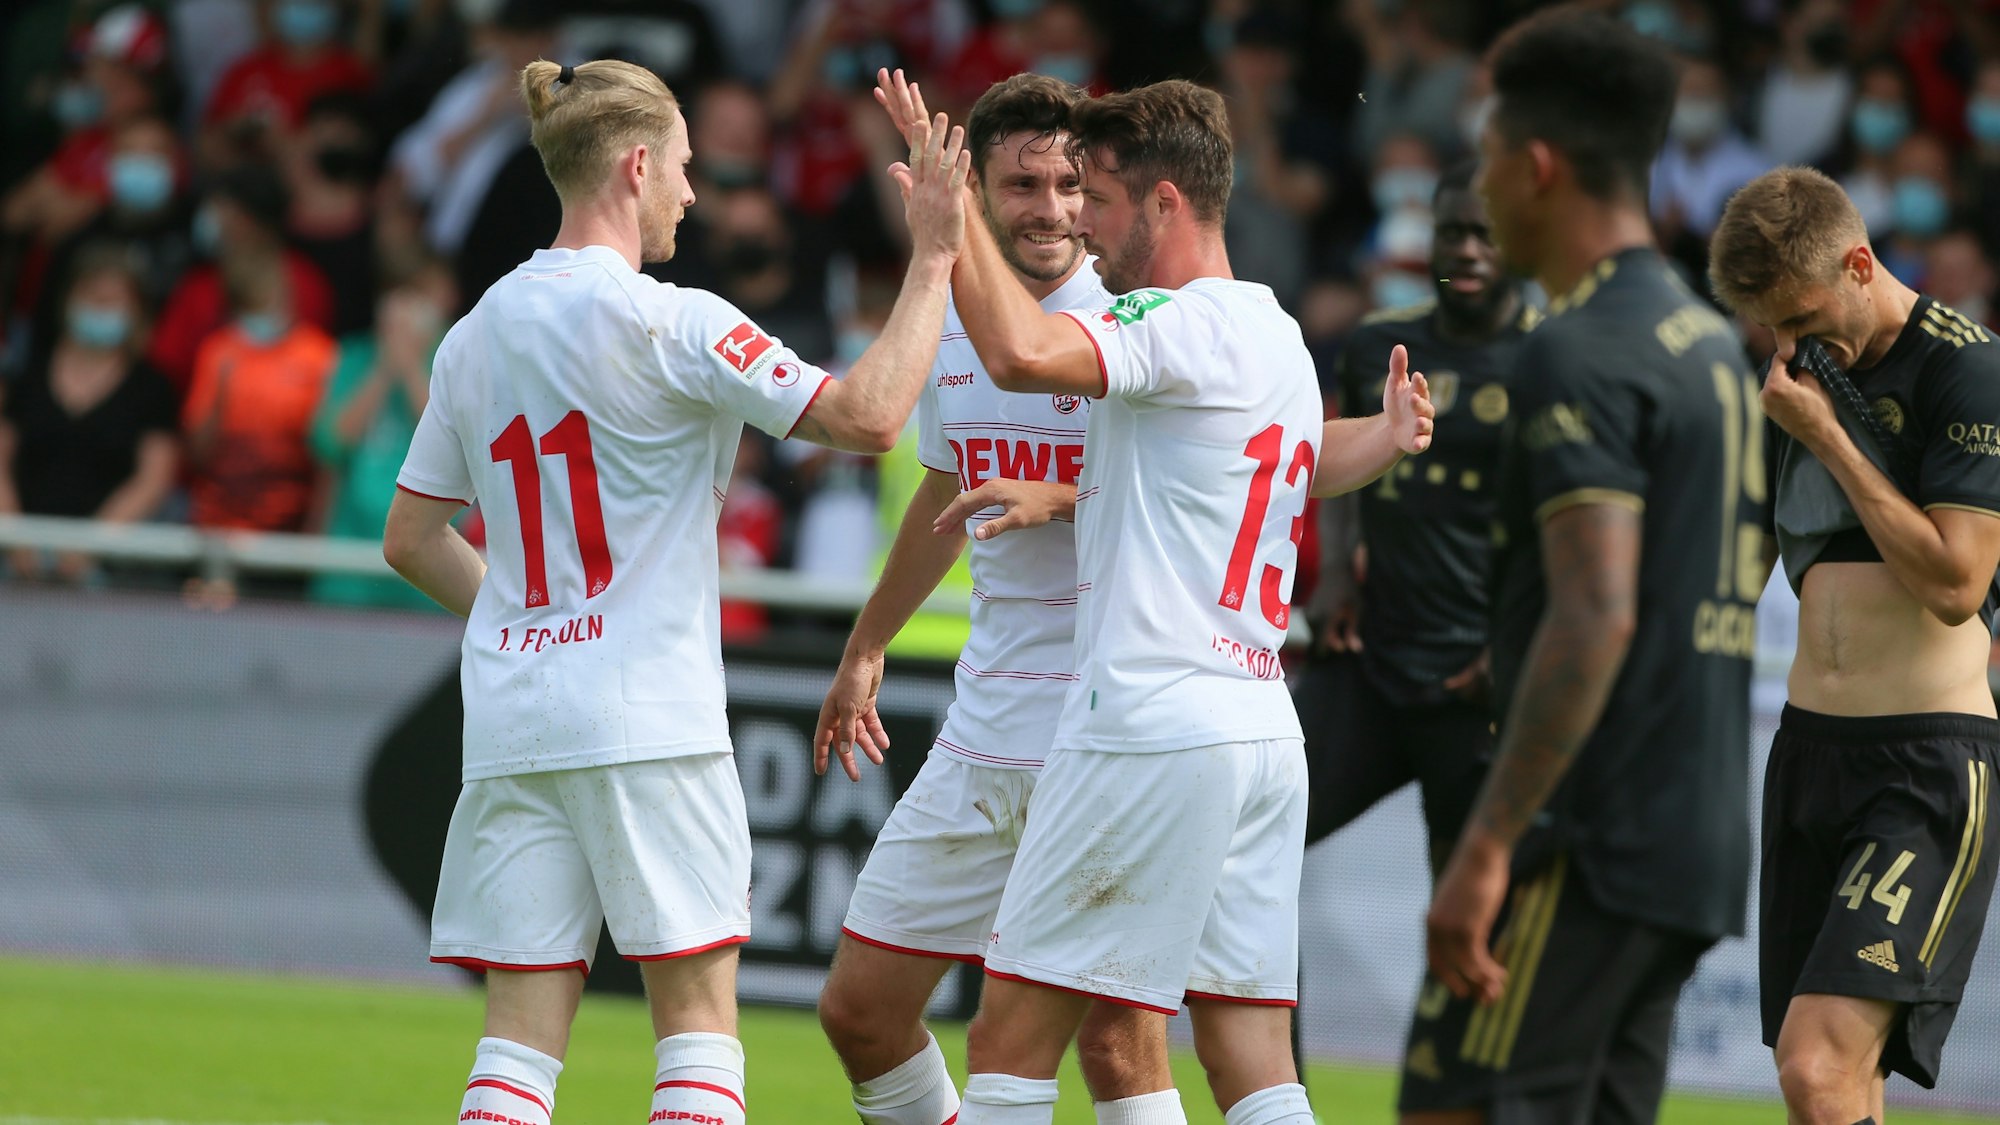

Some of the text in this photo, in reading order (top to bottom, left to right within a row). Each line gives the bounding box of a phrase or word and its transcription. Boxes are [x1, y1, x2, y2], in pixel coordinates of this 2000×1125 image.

[937, 371, 974, 389] uhlsport
[489, 410, 613, 609] 11
[1218, 423, 1315, 631] 13
[1838, 842, 1916, 925] 44
[1857, 948, 1900, 973] adidas
